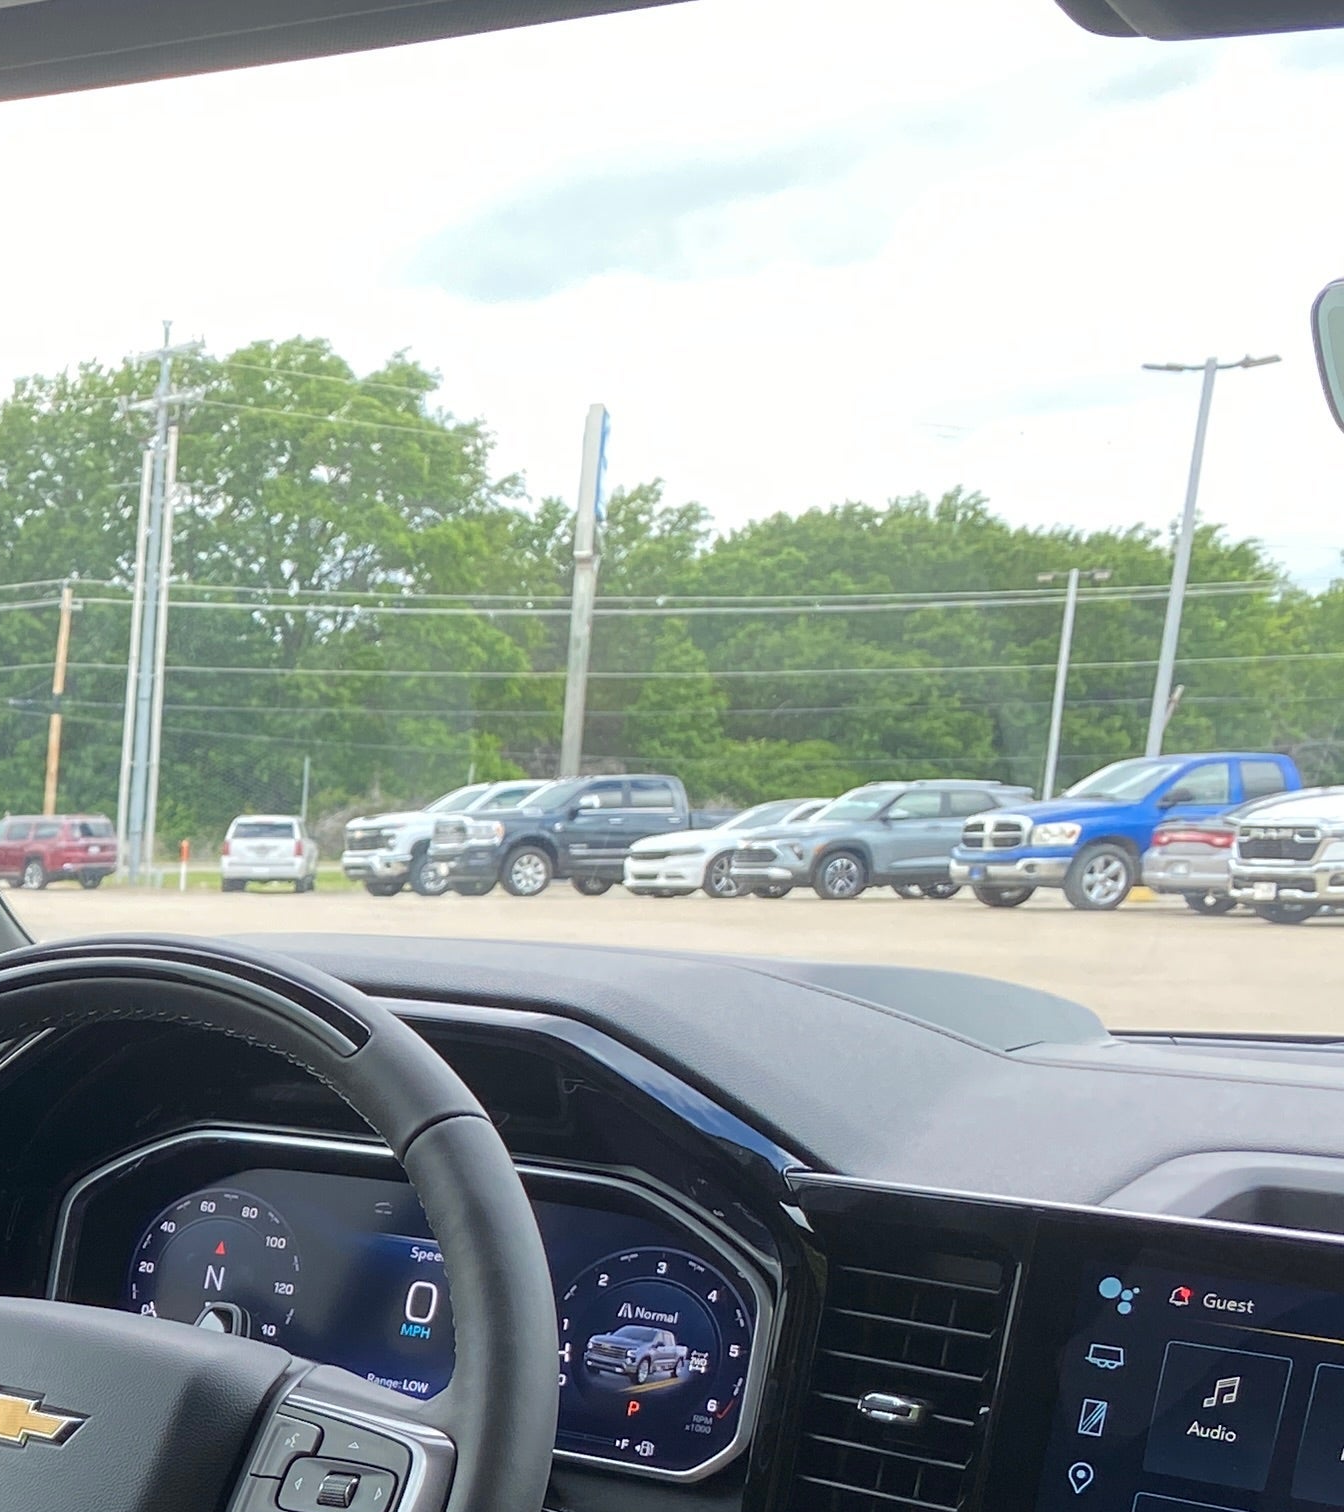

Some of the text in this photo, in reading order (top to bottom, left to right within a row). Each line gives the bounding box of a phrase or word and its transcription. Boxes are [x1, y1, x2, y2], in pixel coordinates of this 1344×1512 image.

[200, 1201, 216, 1213] 60
[241, 1206, 258, 1219] 80
[160, 1221, 176, 1233] 40
[265, 1235, 286, 1249] 100
[410, 1246, 445, 1263] Spee
[138, 1261, 155, 1273] 20
[656, 1261, 667, 1274] 3
[203, 1264, 226, 1291] N
[598, 1274, 609, 1287] 2
[274, 1281, 294, 1295] 120
[405, 1281, 438, 1323] 0
[707, 1290, 718, 1303] 4
[1202, 1292, 1255, 1315] Guest
[634, 1306, 679, 1324] Normal
[400, 1323, 431, 1339] MPH
[562, 1318, 569, 1331] 1
[729, 1344, 740, 1358] 5
[402, 1378, 429, 1394] LOW
[627, 1401, 640, 1416] P
[707, 1399, 717, 1412] 6
[692, 1414, 713, 1425] RPM
[1186, 1420, 1237, 1444] Audio
